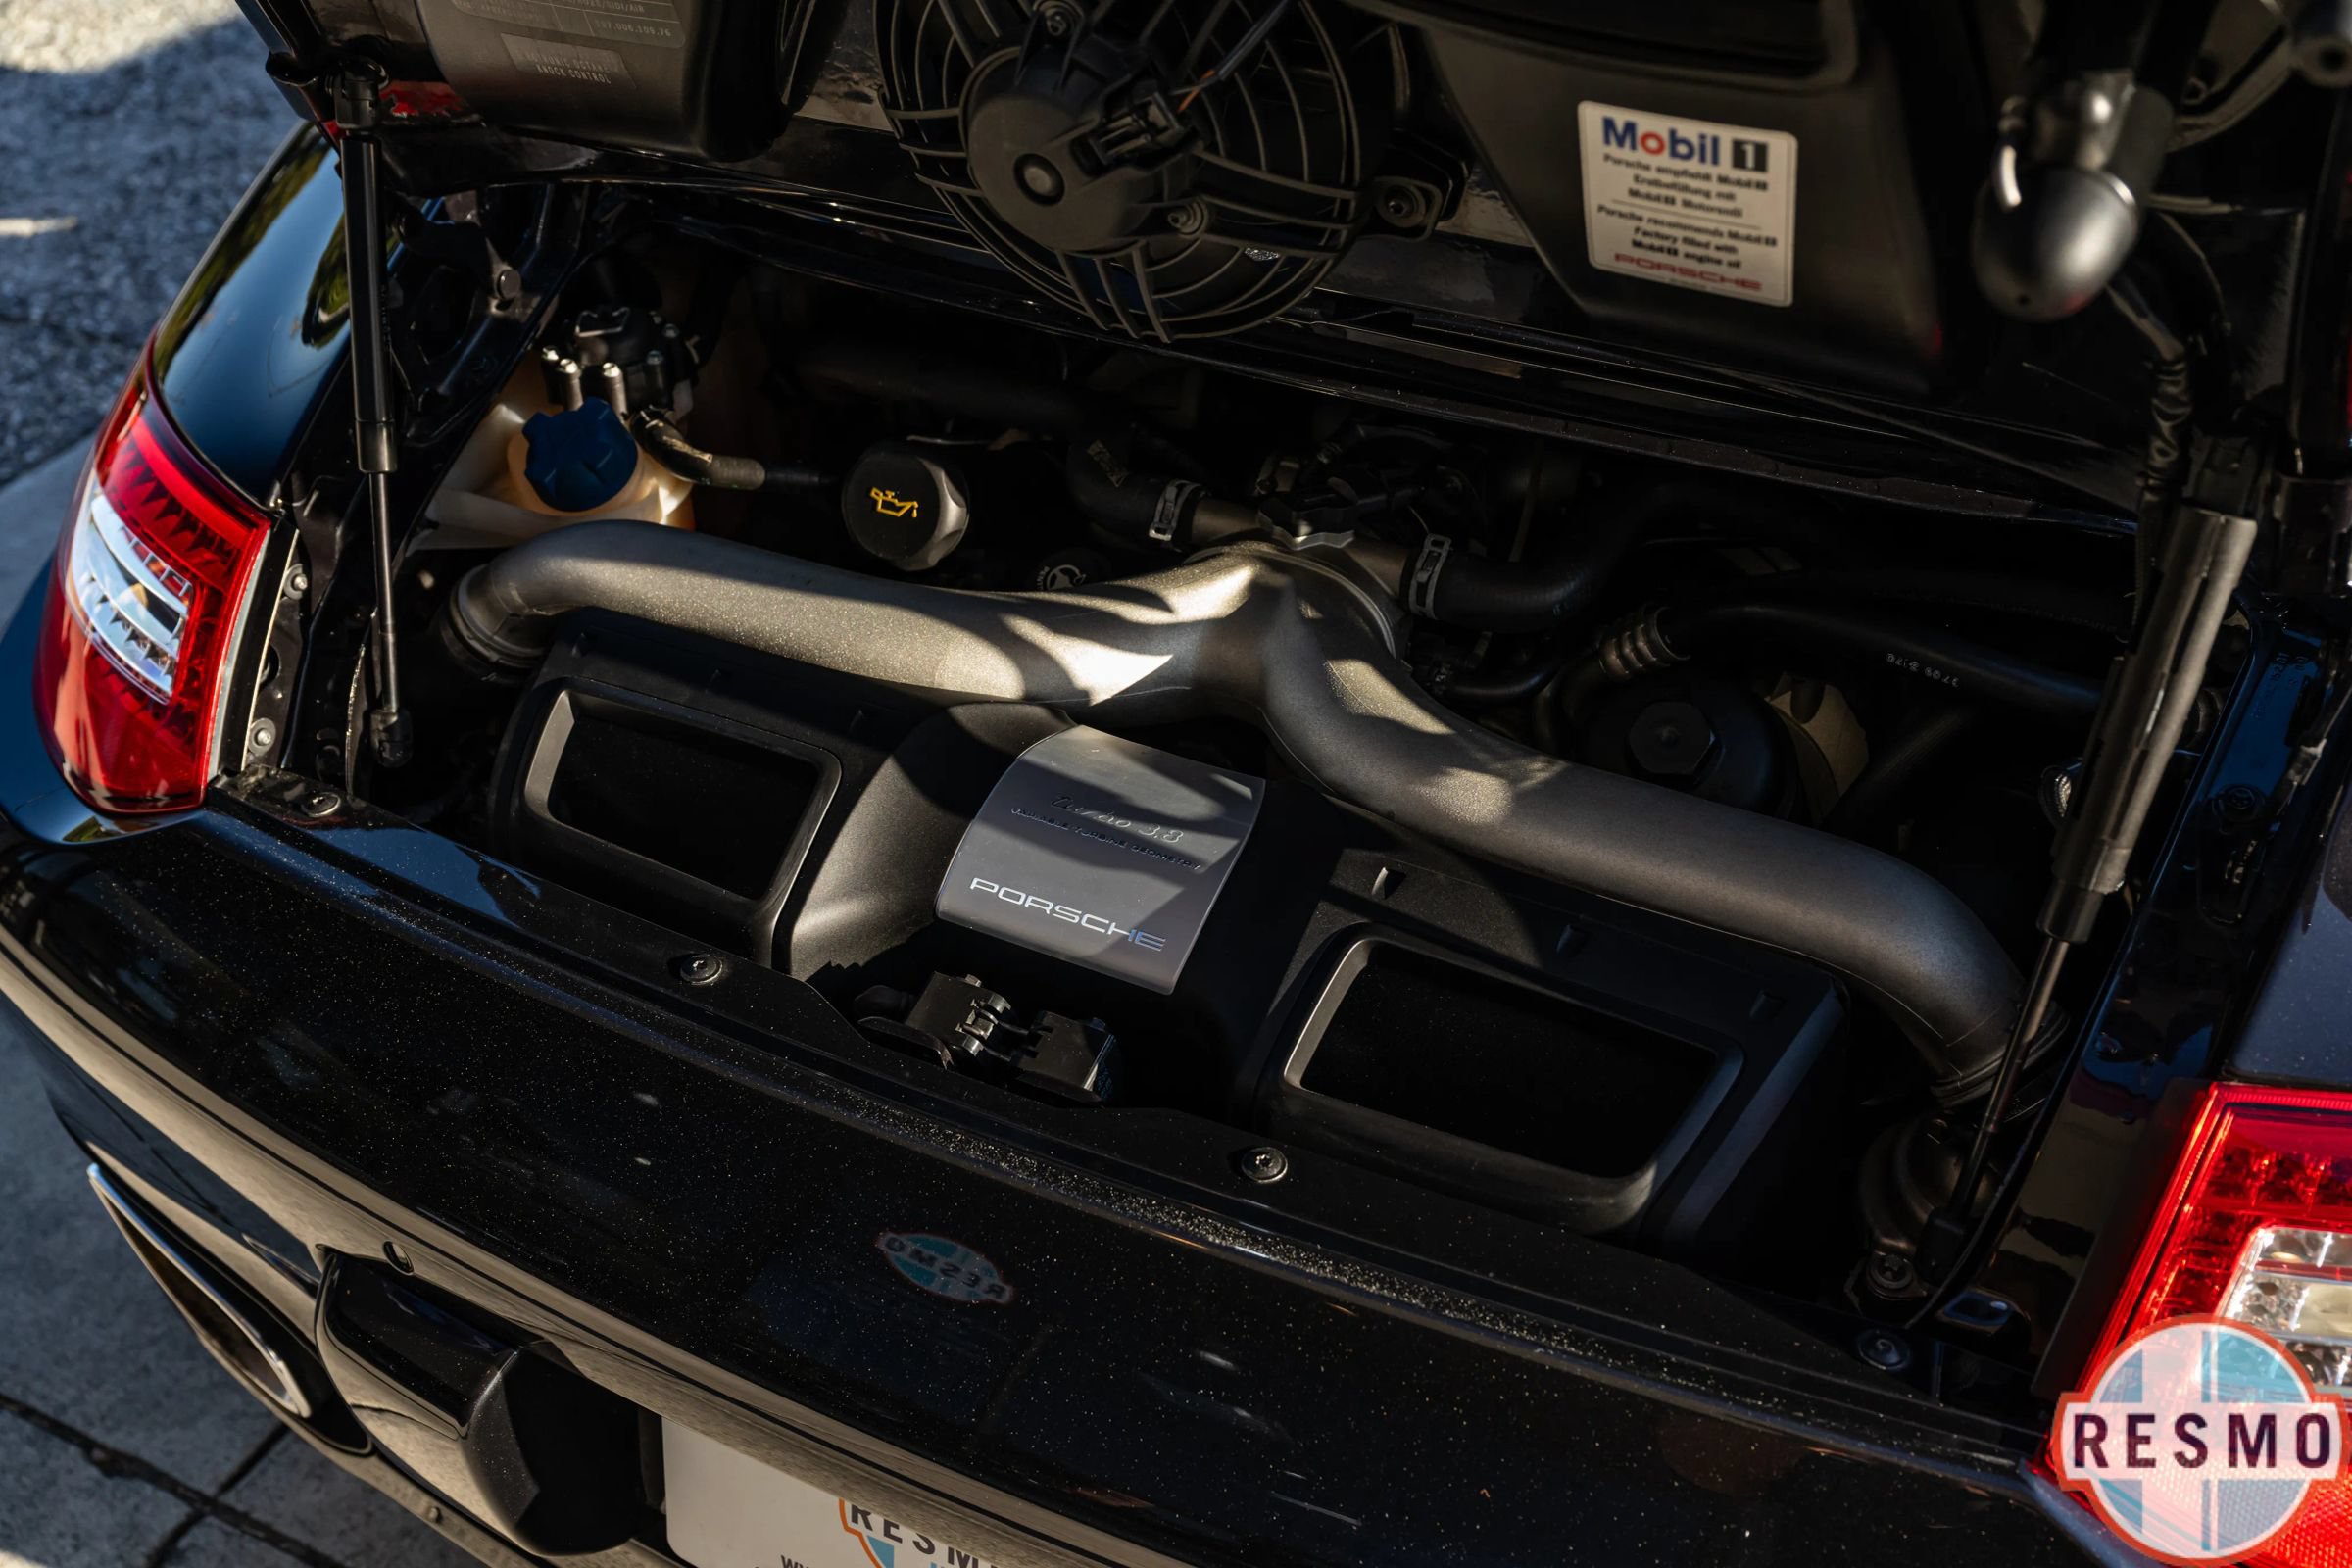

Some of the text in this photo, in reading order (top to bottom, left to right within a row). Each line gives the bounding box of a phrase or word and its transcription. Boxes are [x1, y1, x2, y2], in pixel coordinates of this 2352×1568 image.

[568, 69, 612, 84] CONTROL
[1602, 115, 1721, 166] Mobil
[1614, 253, 1762, 291] PORSCHE
[1073, 826, 1127, 849] TURBINE
[1138, 823, 1184, 843] 3.8
[970, 877, 1166, 952] PORSCHE
